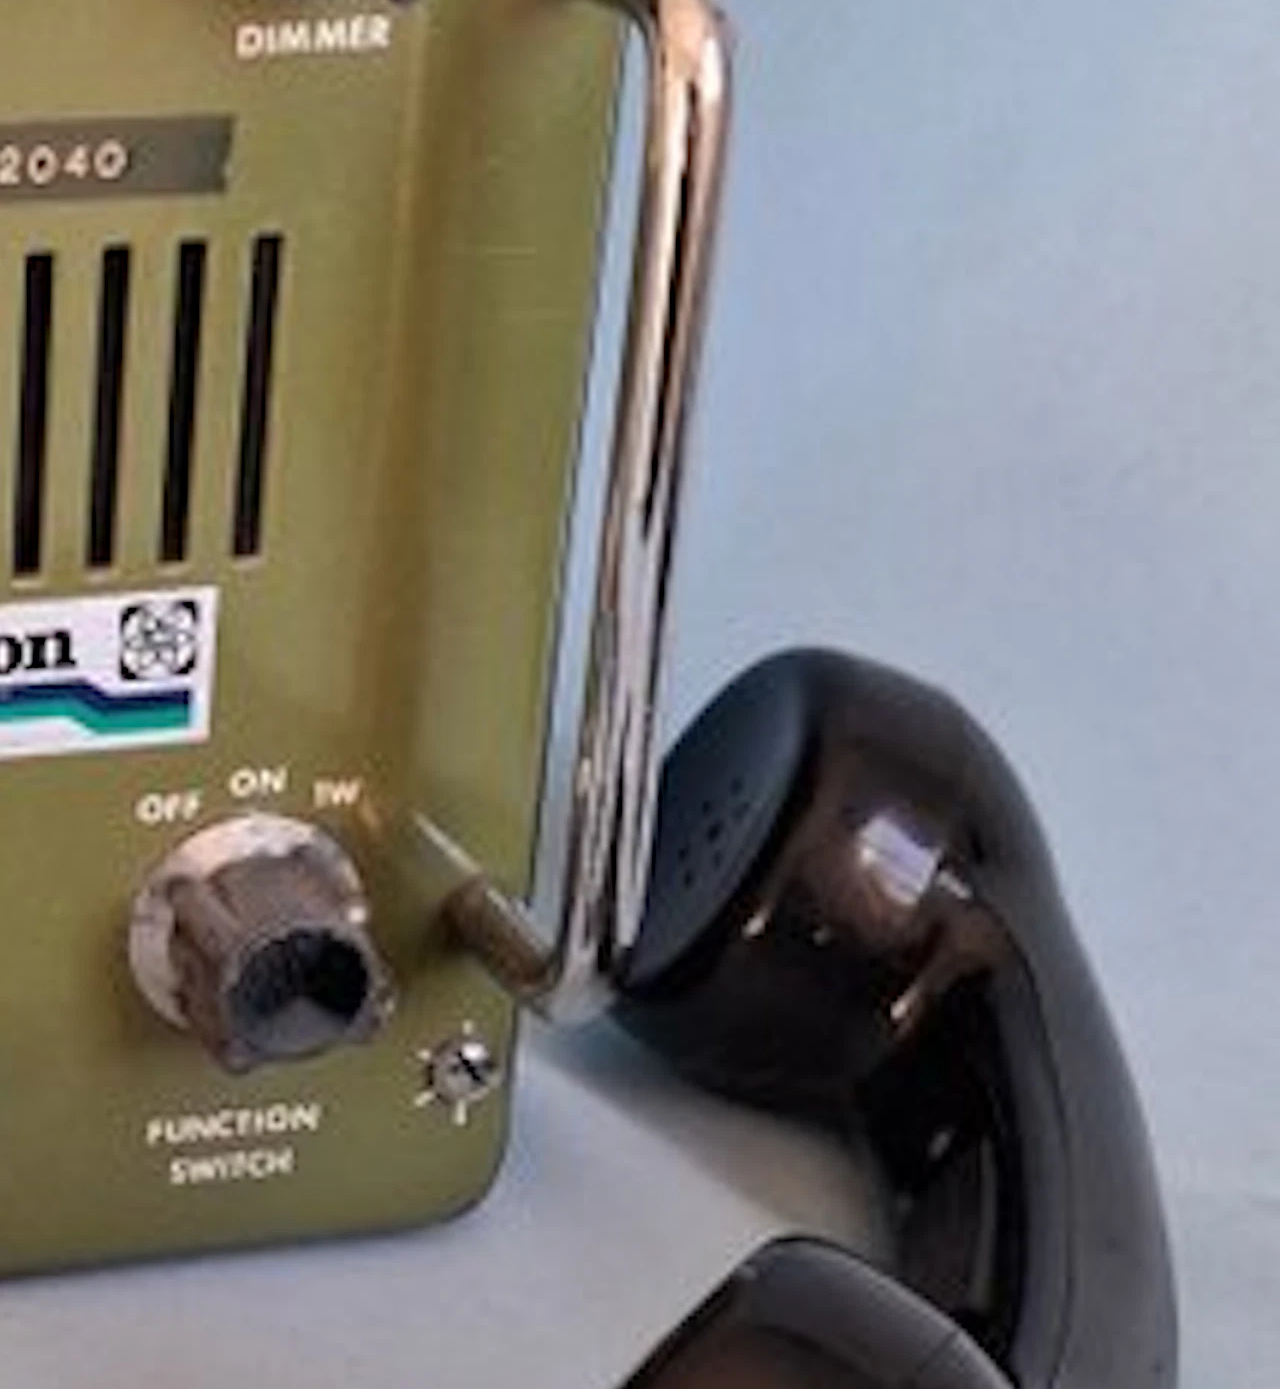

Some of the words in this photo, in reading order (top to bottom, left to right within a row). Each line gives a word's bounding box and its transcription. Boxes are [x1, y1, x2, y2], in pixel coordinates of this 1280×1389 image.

[236, 14, 391, 60] DIMMER
[228, 768, 288, 797] ON
[135, 794, 201, 823] OFF
[146, 1103, 321, 1145] FUNCTION
[170, 1147, 295, 1185] SWITCH
